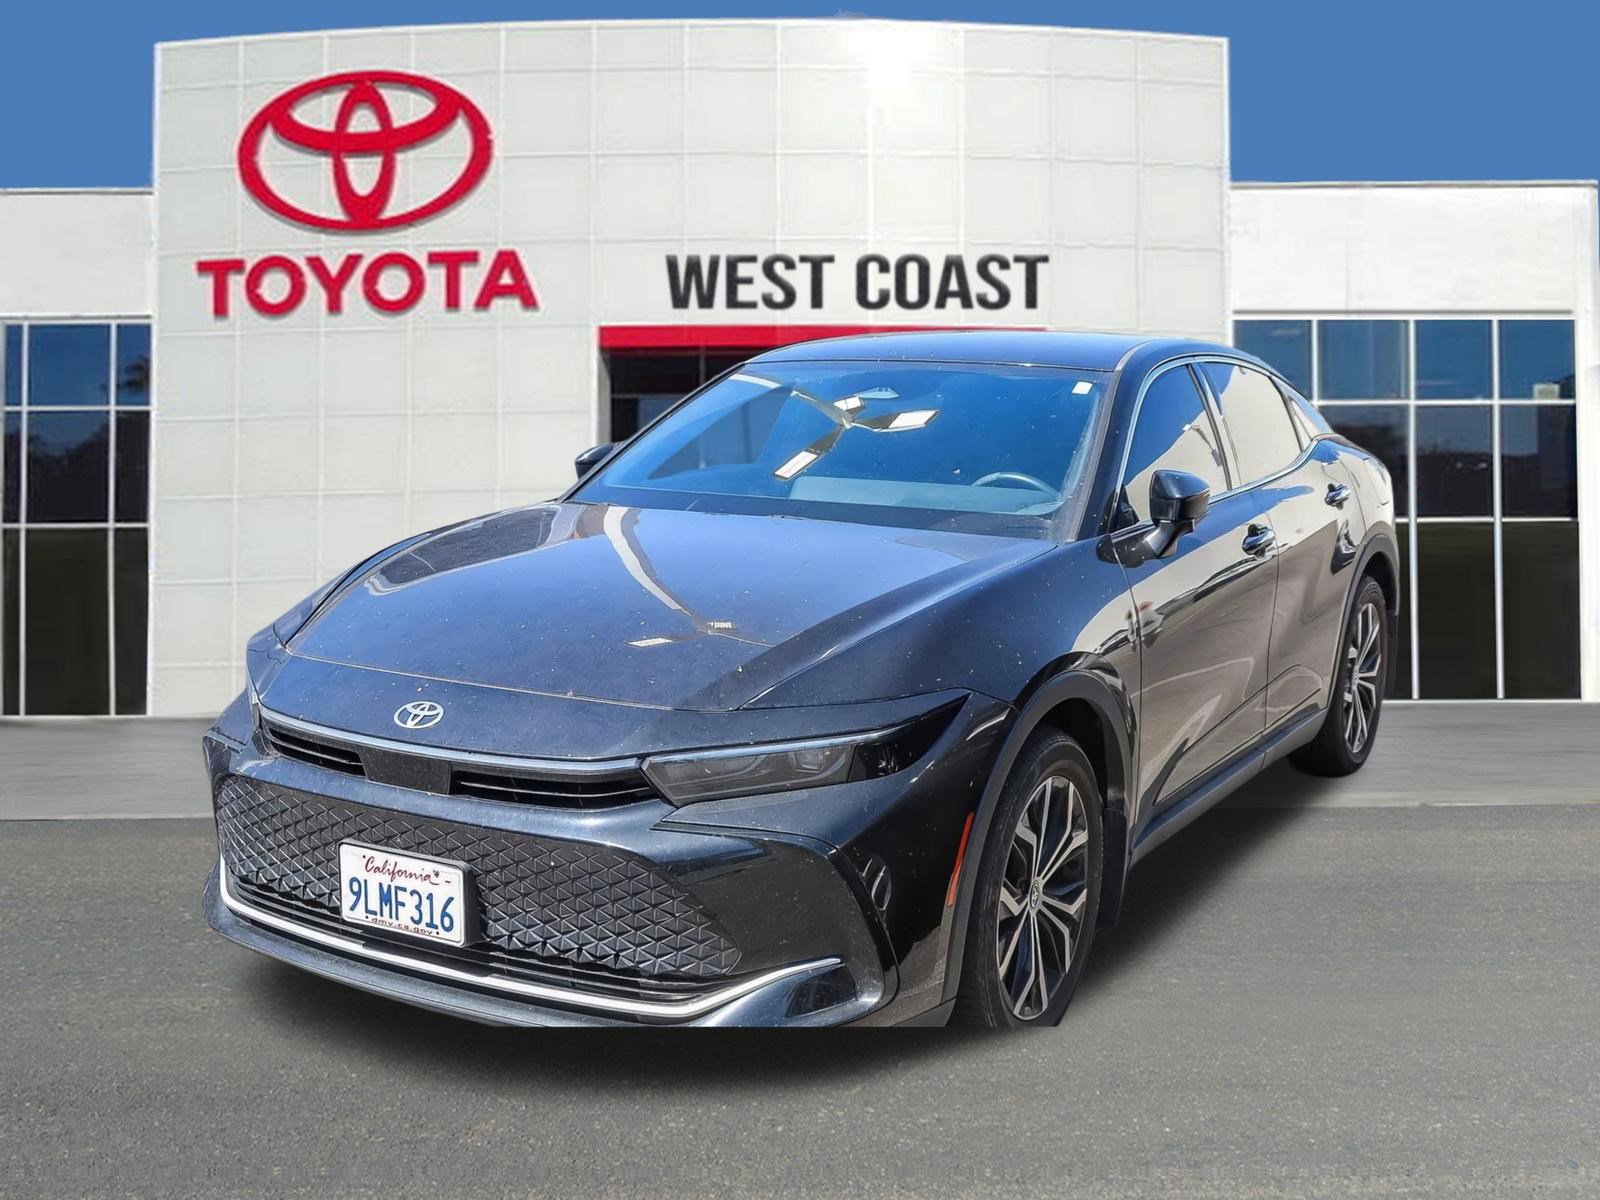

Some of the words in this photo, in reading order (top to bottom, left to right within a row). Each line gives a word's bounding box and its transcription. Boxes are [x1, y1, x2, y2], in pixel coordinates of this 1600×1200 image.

[196, 250, 539, 317] TOYOTA
[665, 254, 835, 310] WEST
[855, 254, 1050, 310] COAST
[364, 855, 440, 886] California
[348, 876, 455, 933] 9LMF316
[371, 917, 433, 936] dmv.ca.gov
